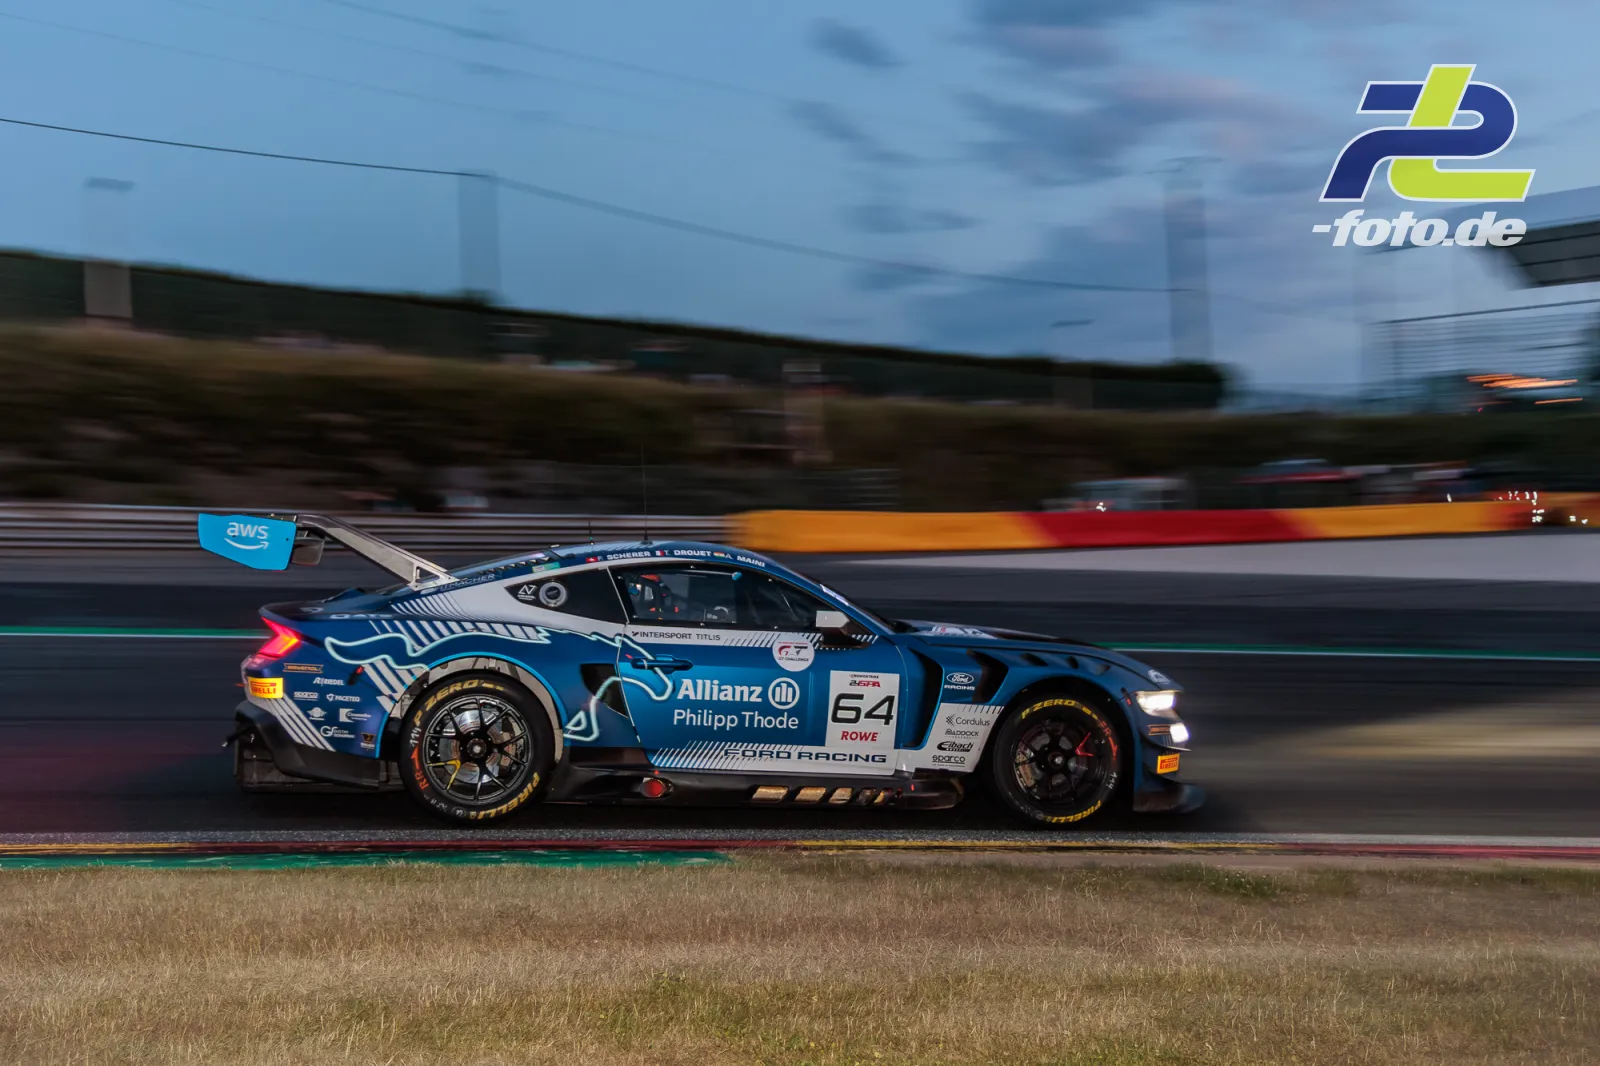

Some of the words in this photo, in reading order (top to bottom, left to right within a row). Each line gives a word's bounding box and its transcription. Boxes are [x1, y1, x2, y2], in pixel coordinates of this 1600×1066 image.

[226, 521, 269, 540] aws
[606, 551, 652, 561] SCHERER
[673, 549, 712, 557] DROUET
[736, 555, 766, 568] MAINI
[640, 631, 692, 640] INTERSPORT
[696, 633, 721, 641] TITLIS
[951, 673, 969, 683] Ford
[425, 679, 479, 712] ZERO
[677, 679, 763, 702] Allianz
[831, 693, 895, 725] 64
[1032, 698, 1077, 712] ZERO
[673, 708, 738, 731] Philipp
[741, 711, 799, 729] Thode
[955, 716, 991, 726] Cordulus
[841, 731, 879, 742] ROWE
[937, 740, 974, 752] Eibach
[723, 749, 791, 760] FORD
[797, 751, 887, 763] RACING
